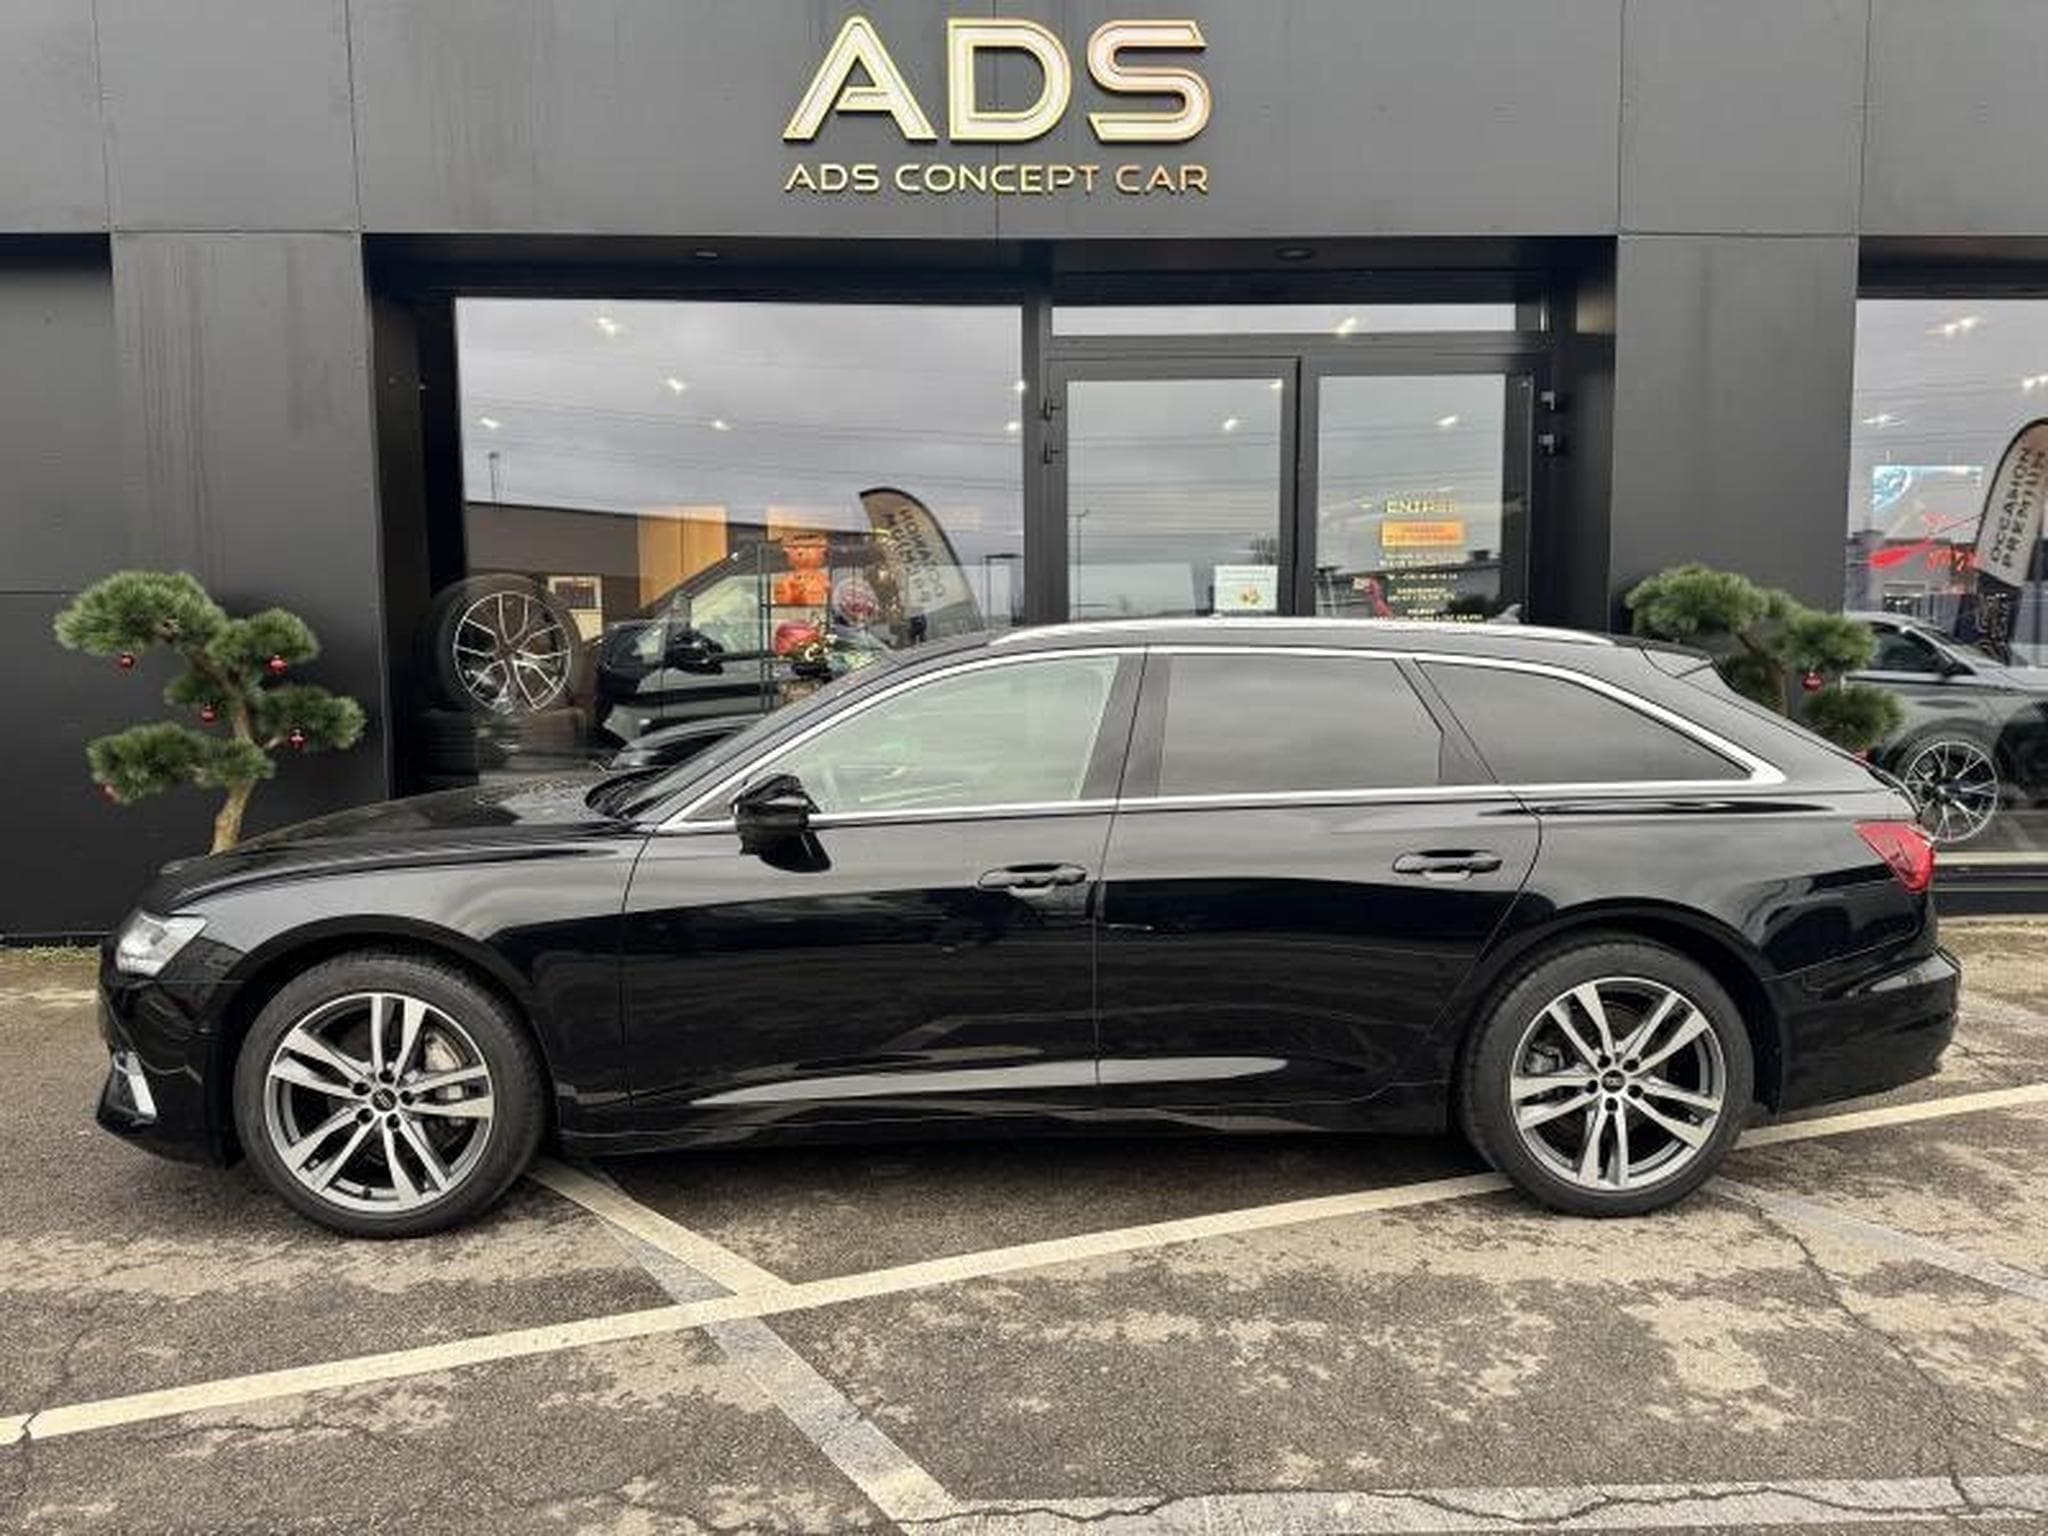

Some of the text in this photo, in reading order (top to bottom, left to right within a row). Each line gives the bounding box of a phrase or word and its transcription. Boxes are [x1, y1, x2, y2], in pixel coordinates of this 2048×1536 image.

[783, 15, 1210, 143] ADS
[784, 163, 1208, 194] ADS CONCEPT CAR
